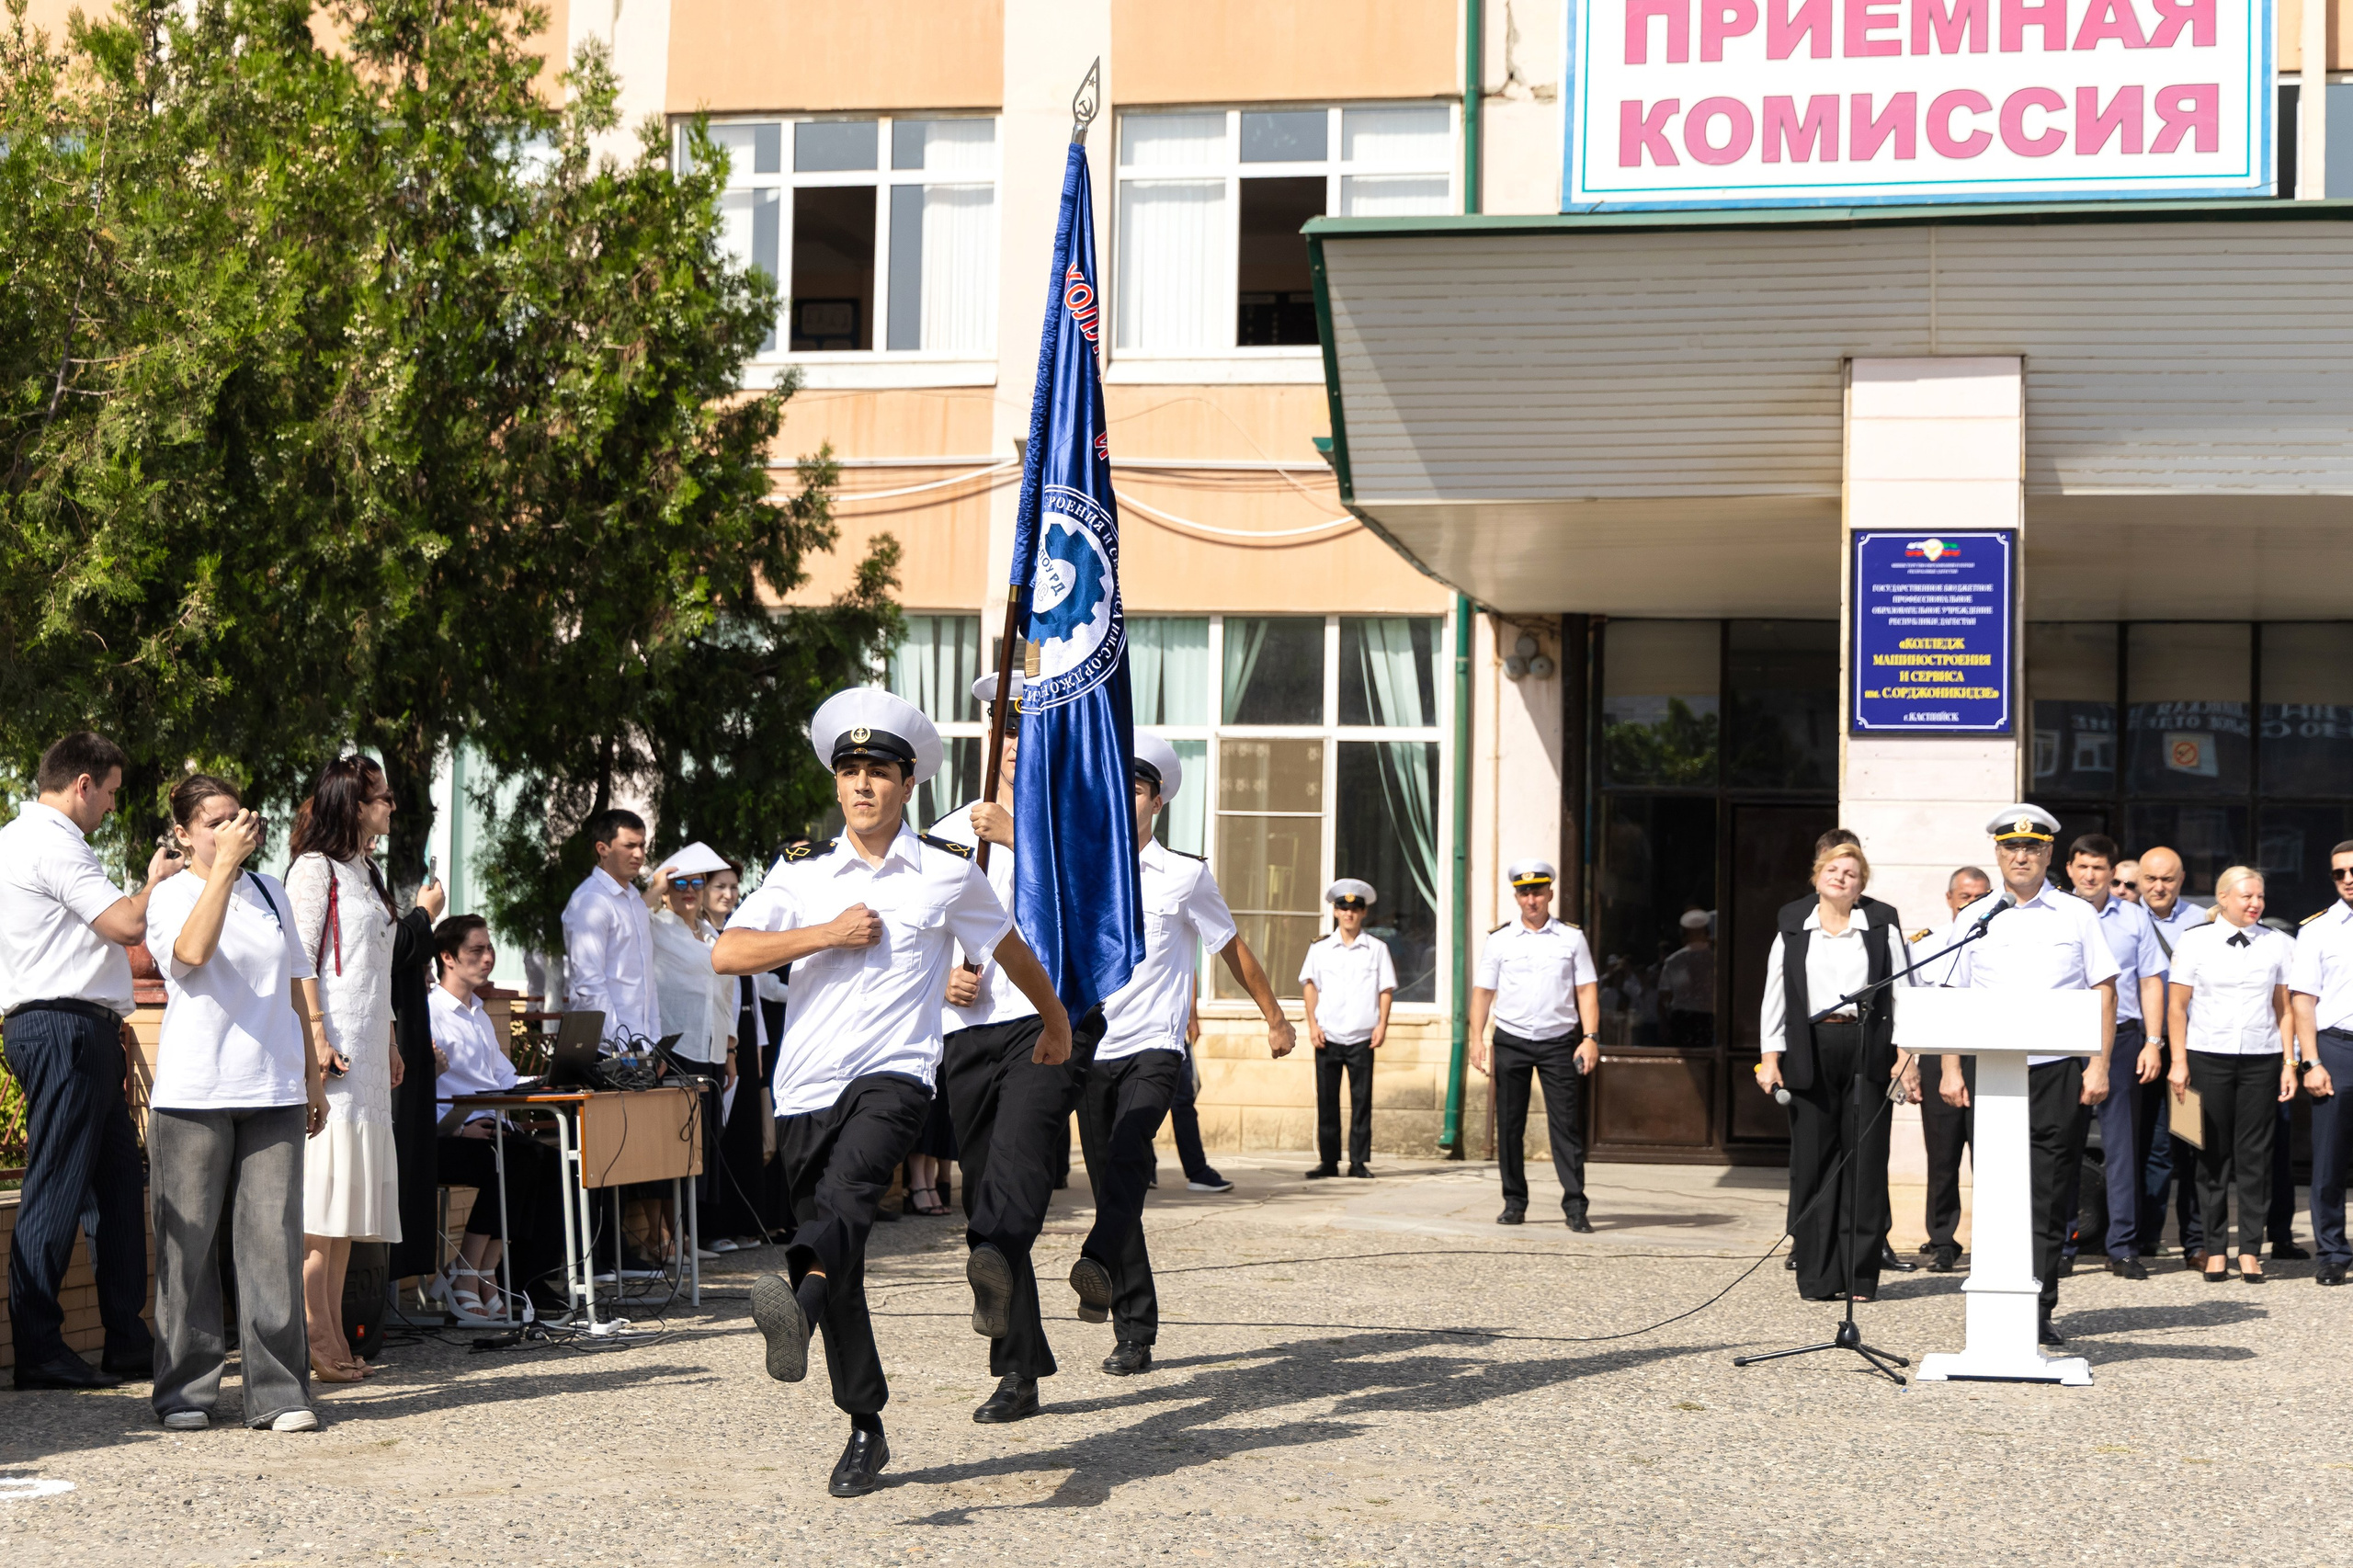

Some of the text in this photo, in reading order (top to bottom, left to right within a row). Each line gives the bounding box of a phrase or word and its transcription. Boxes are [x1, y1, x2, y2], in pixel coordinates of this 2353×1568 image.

[1618, 83, 2220, 167] КОМИССИЯ
[1044, 495, 1106, 532] РОЕНИЯ
[1049, 573, 1066, 597] РД
[1899, 637, 1965, 650] «КОЛЛЕДЖ
[1872, 653, 1992, 666] МАШИНОСТРОЕНИЯ
[1899, 670, 1965, 682] И СЕРВИСА
